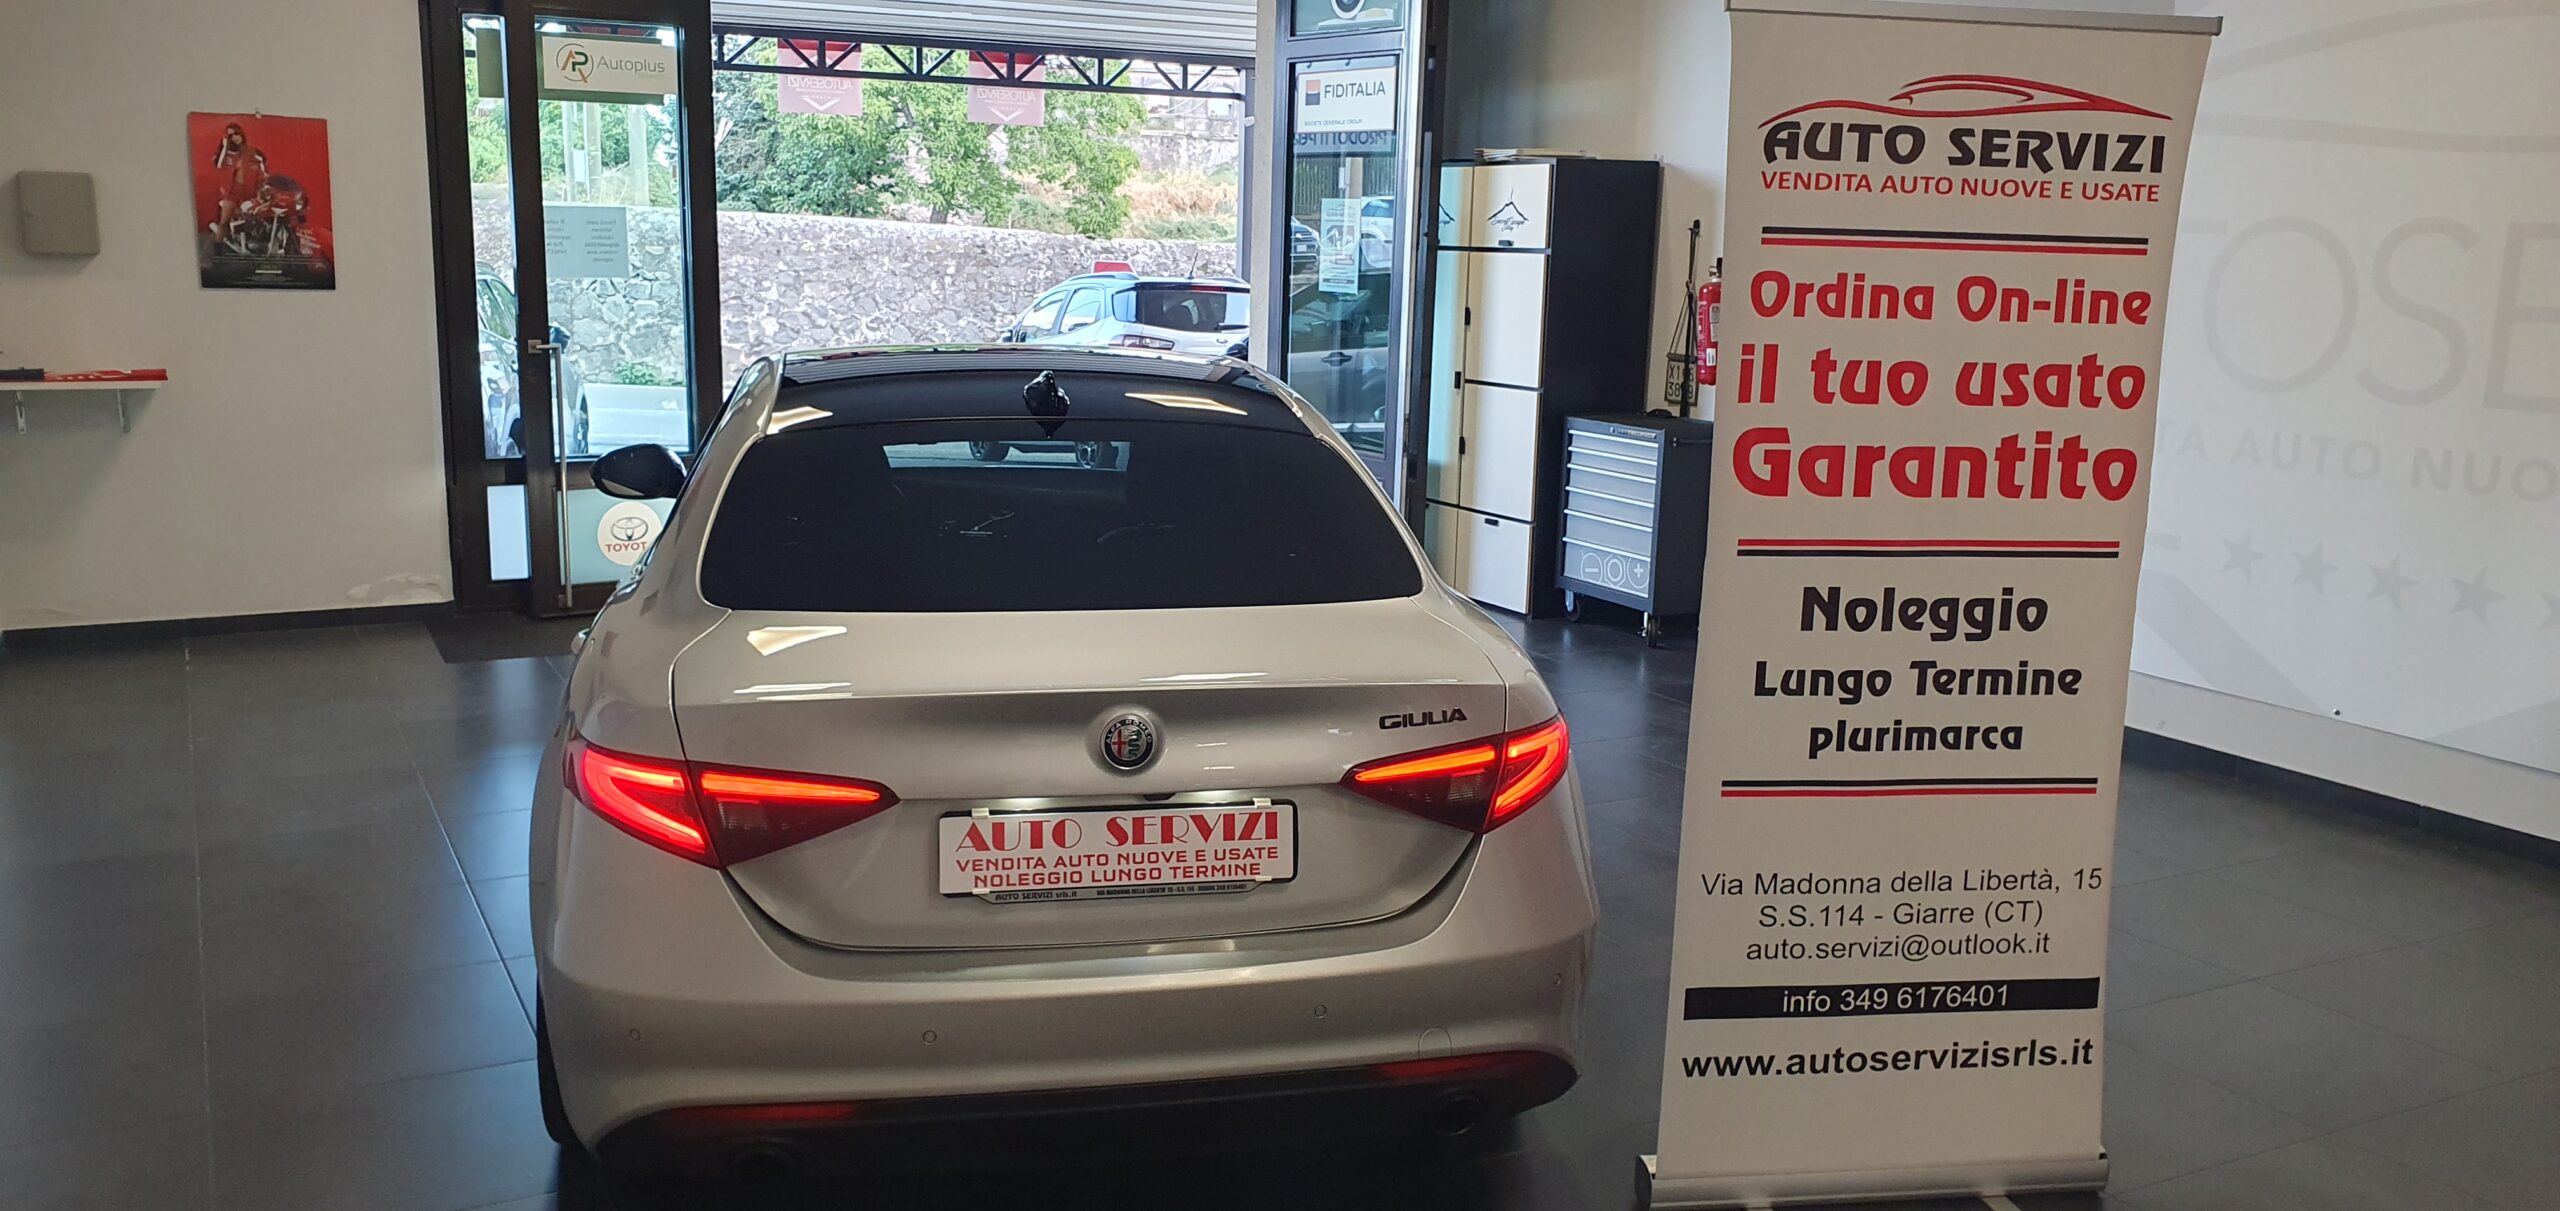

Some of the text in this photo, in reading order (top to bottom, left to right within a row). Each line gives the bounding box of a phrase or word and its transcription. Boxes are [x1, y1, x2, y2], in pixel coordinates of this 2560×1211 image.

[597, 55, 665, 75] Autoplus
[1324, 81, 1386, 98] FIDITALIA
[1762, 121, 2166, 174] AUTO SERVIZI
[1761, 170, 2160, 203] VENDITA AUTO NUOVE E USATE
[1750, 270, 2152, 325] Ordina On-line
[1667, 381, 1694, 400] 389
[1737, 343, 2146, 410] il tuo usato
[1732, 427, 2138, 501] Garantito
[2229, 426, 2382, 480] AUTO
[2409, 446, 2560, 502] NUO
[1800, 586, 2048, 642] Noleggio
[1754, 660, 2082, 705] Lungo Termine
[1105, 719, 1152, 744] ALFA ROMEO
[1379, 707, 1467, 729] GIULIA
[1808, 719, 2023, 760] plurimarca
[955, 812, 1278, 852] AUTO SERVIZI
[956, 846, 1278, 872] VENDITA AUTO NUOVE E USATE
[974, 863, 1261, 888] NOLEGGIO LUNGO TERMINE
[1701, 867, 2103, 896] Via Madonna della Libertà, 15
[995, 893, 1019, 901] AUTO
[1022, 891, 1054, 900] SERVIZI
[1758, 903, 1864, 928] S.S.114
[1893, 901, 1975, 925] Giarre
[1984, 899, 2044, 928] (CT)
[1745, 932, 2050, 961] auto.servizi@outlook.it
[1782, 984, 2009, 1013] info 349 6176401
[1682, 1038, 2094, 1078] www.autoservizisrls.it
